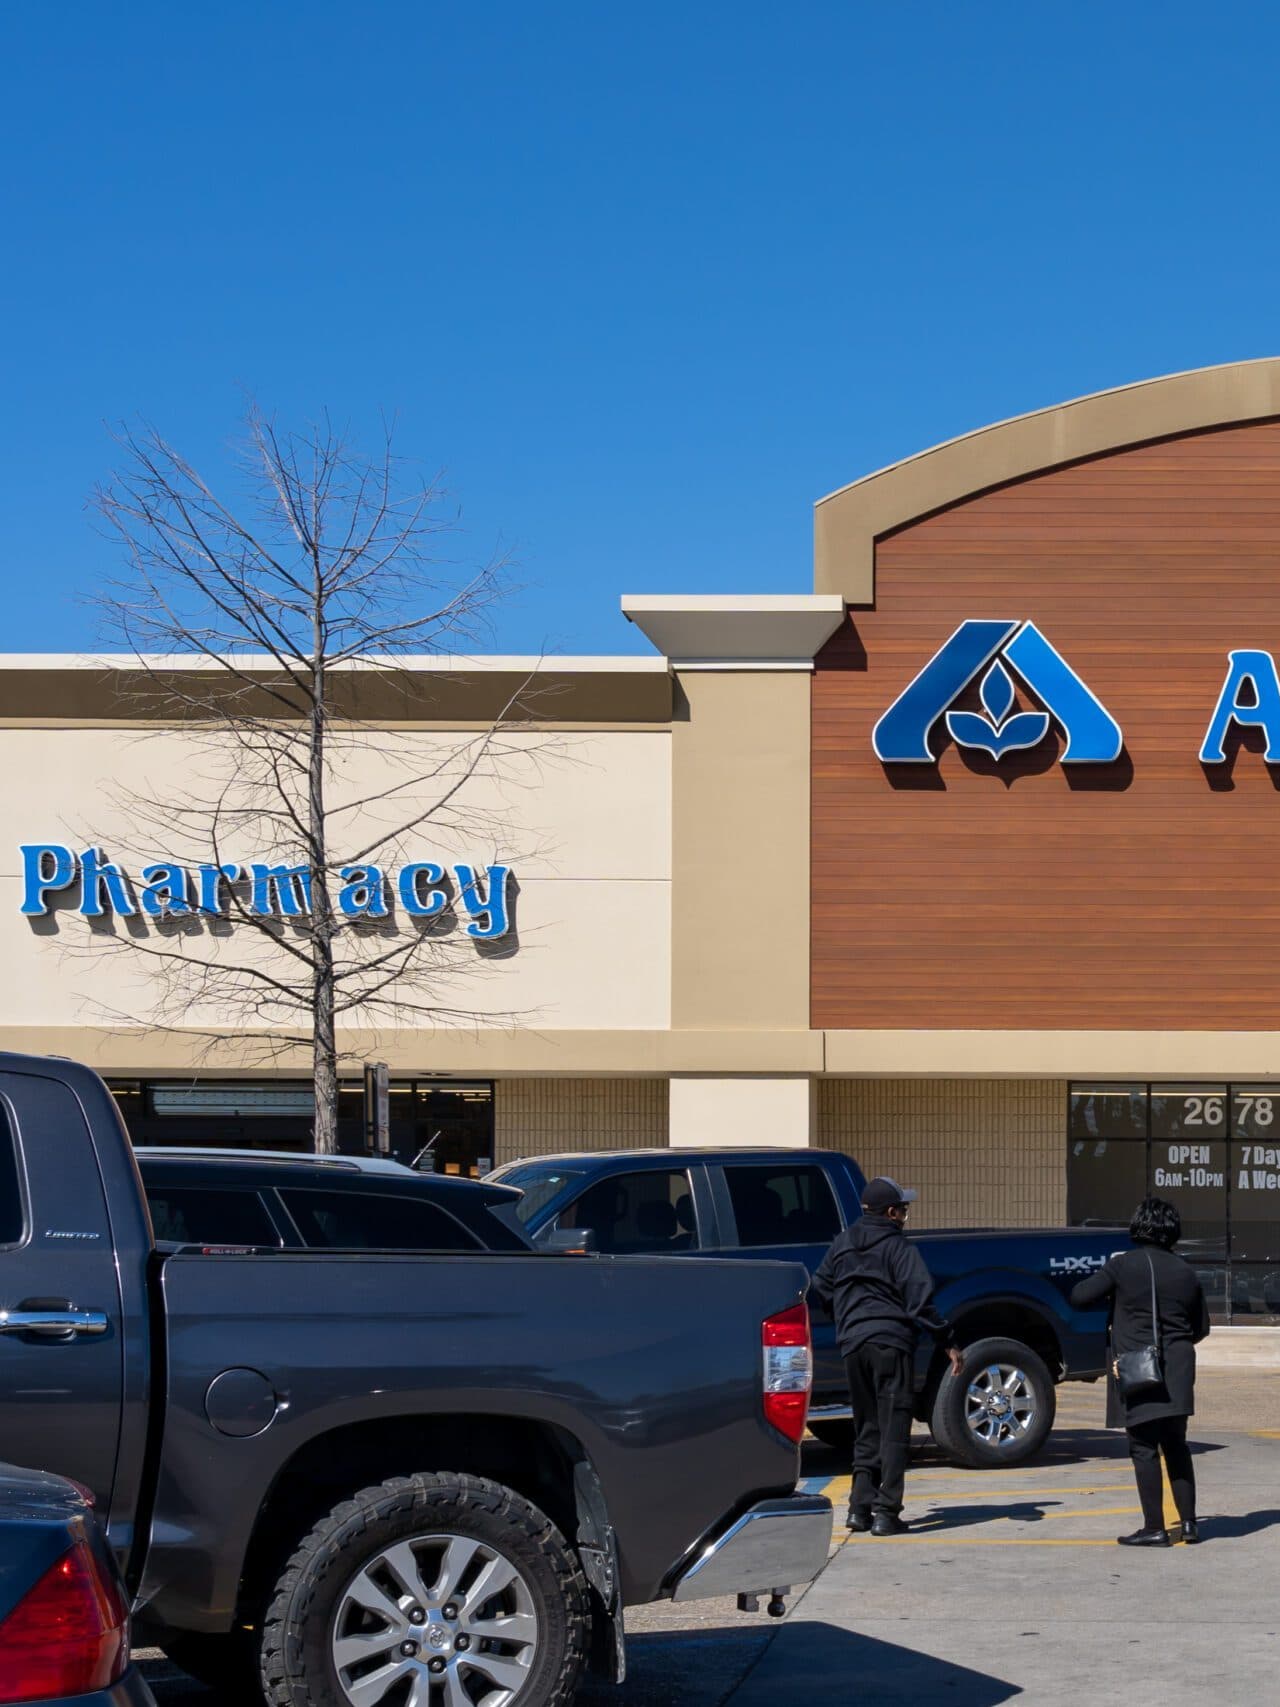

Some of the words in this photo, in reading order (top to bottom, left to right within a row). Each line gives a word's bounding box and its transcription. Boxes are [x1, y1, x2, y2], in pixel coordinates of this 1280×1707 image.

[19, 844, 509, 939] Pharmacy
[1168, 1145, 1211, 1165] OPEN
[1241, 1146, 1251, 1165] 7
[1238, 1170, 1250, 1189] A
